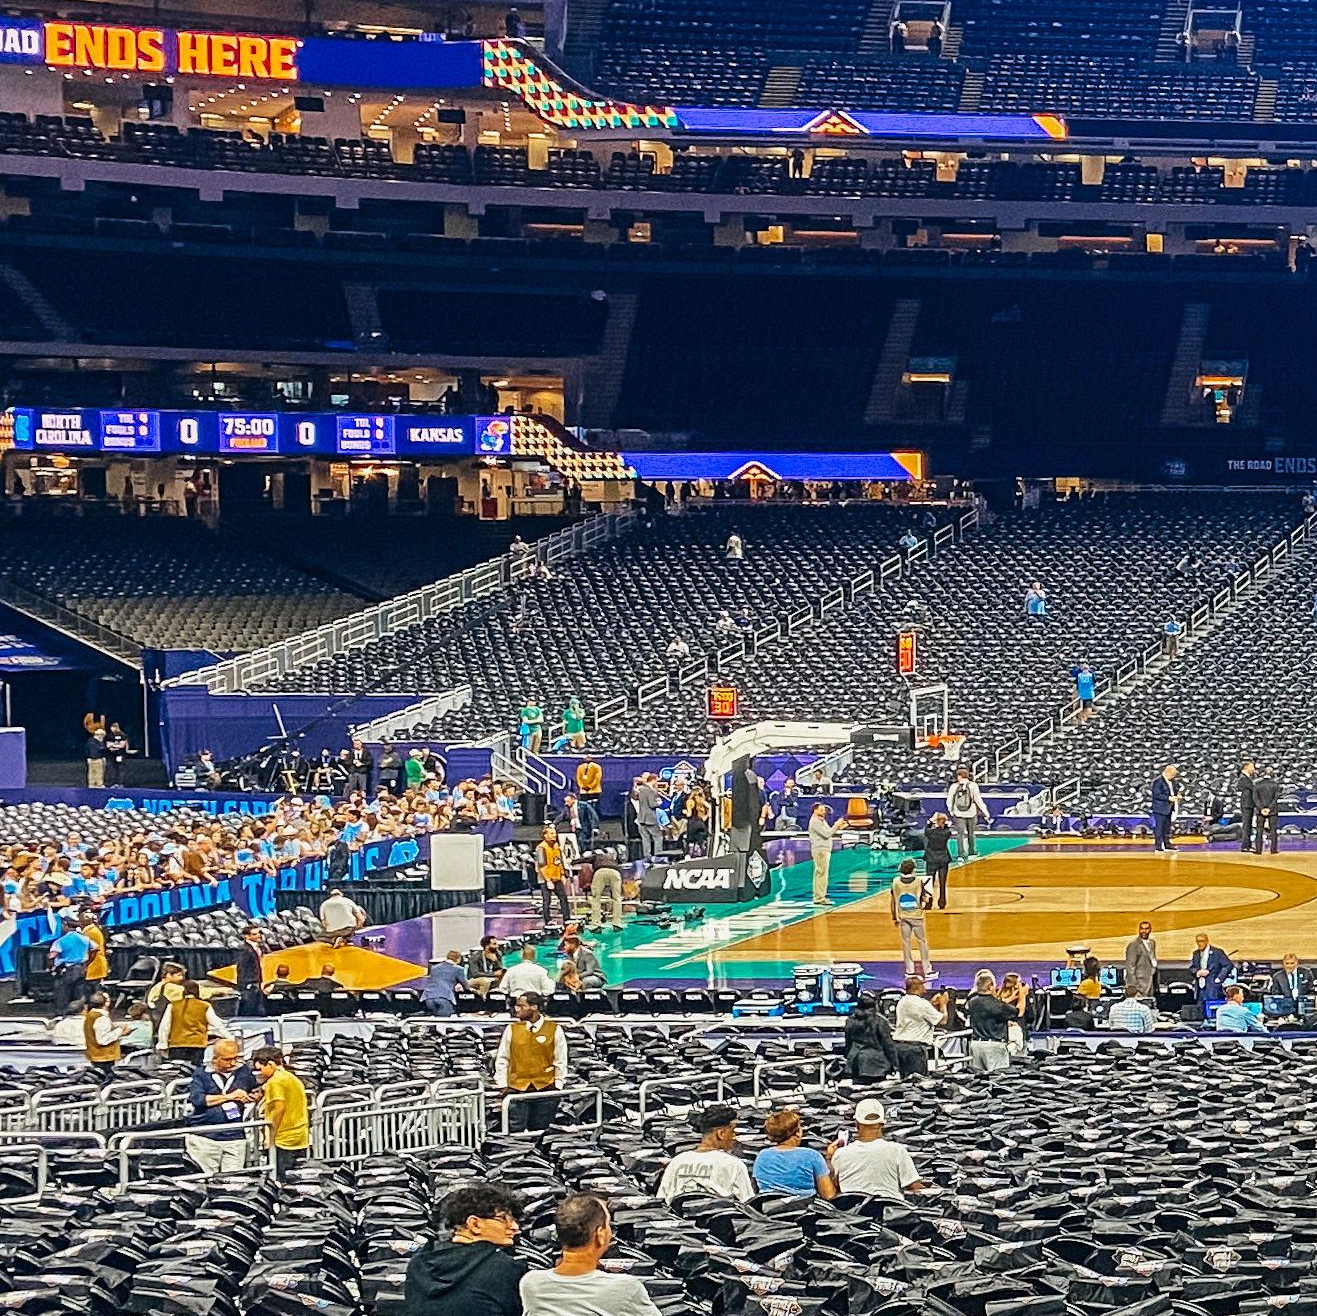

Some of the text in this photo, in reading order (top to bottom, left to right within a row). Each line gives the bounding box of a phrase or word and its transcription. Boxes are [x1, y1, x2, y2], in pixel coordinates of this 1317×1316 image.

[44, 22, 165, 72] ENDS
[177, 32, 298, 80] HERE
[180, 418, 199, 445] 0
[223, 418, 274, 435] 75:00
[299, 421, 316, 446] 0
[409, 428, 463, 443] KANSAS
[1228, 460, 1246, 470] THE
[1248, 460, 1273, 470] ROAD
[1275, 458, 1317, 474] ENDS
[663, 869, 734, 891] NCAA
